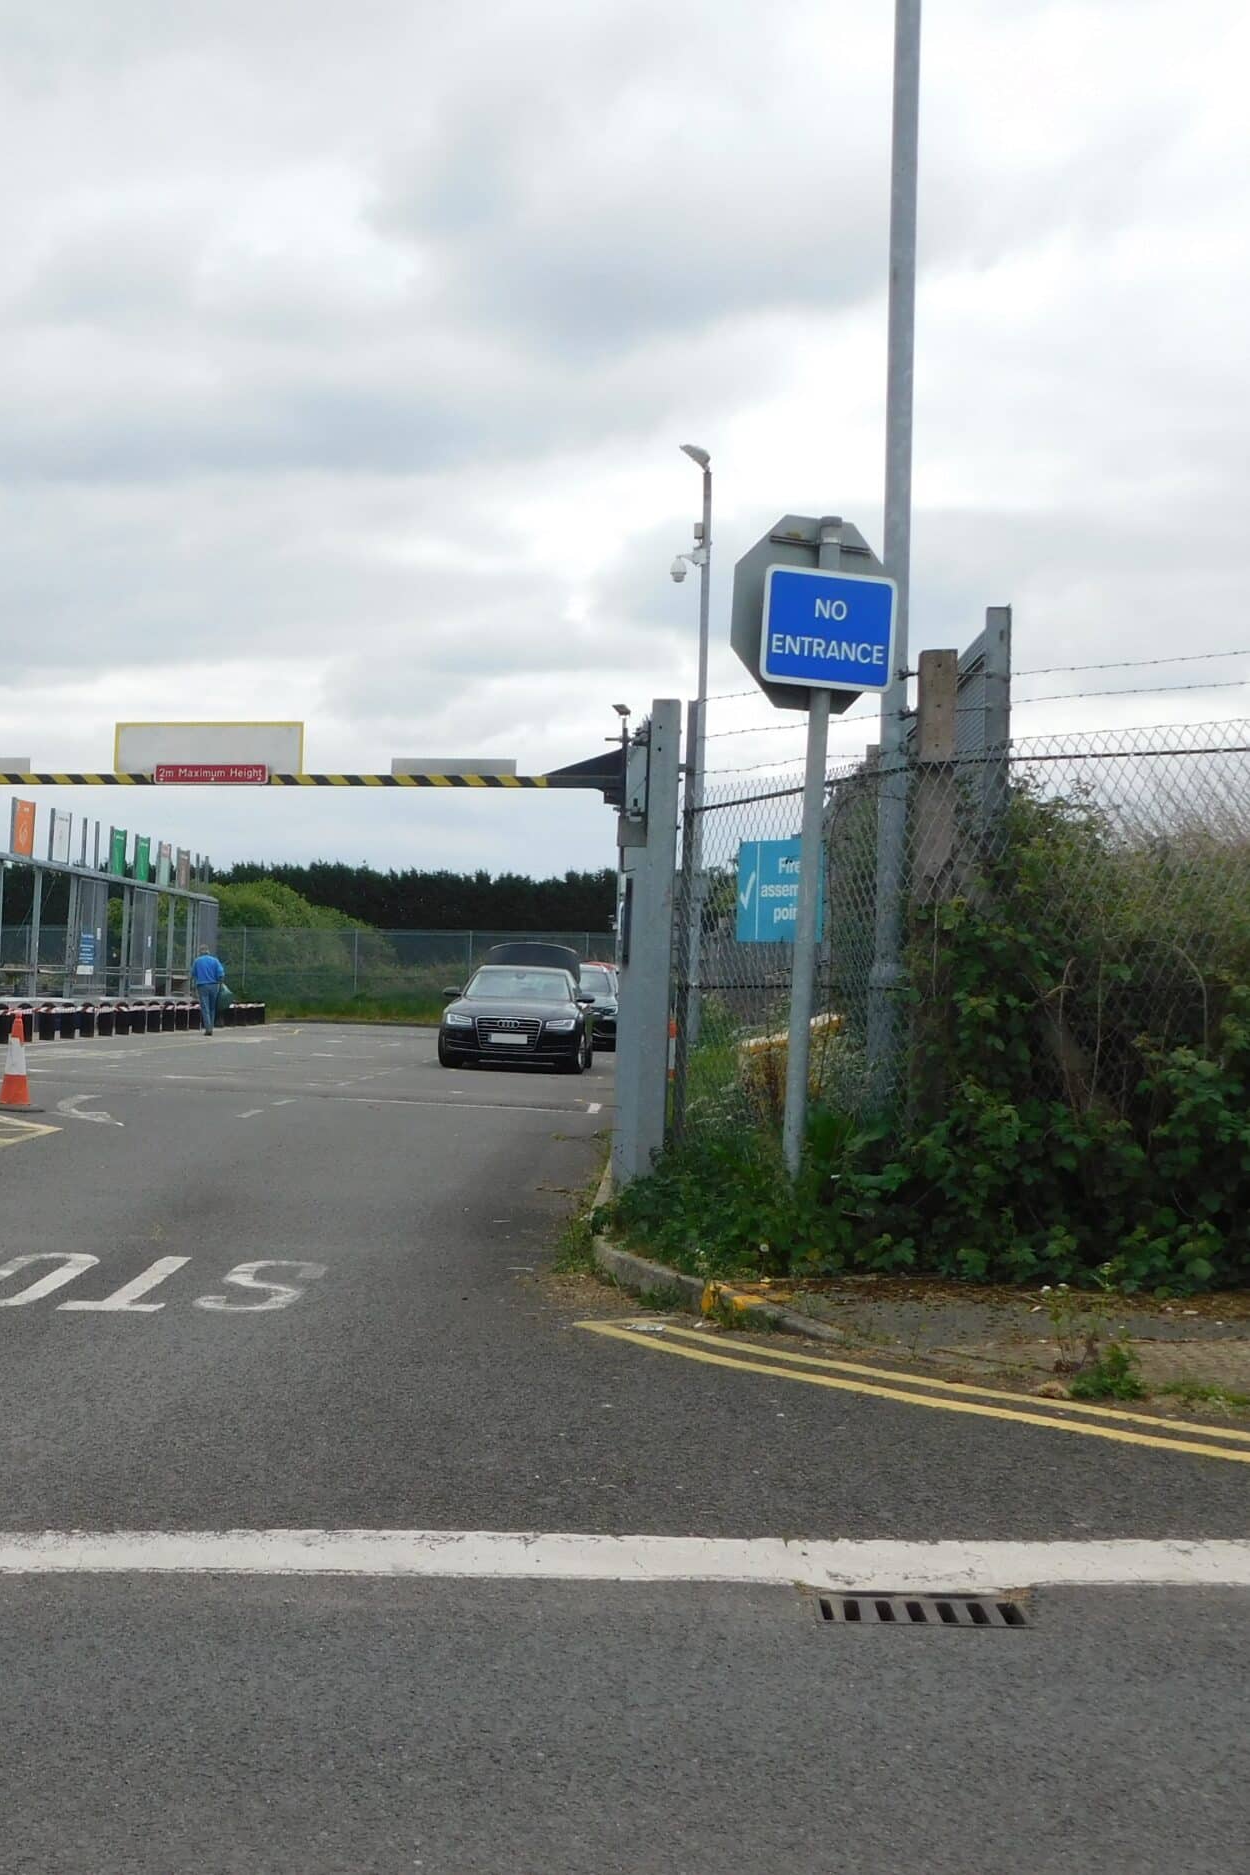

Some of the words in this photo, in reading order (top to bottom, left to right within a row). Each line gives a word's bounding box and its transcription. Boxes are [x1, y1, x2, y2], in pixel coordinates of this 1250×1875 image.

[814, 598, 847, 621] NO
[771, 633, 885, 665] ENTRANCE
[159, 768, 174, 777] 2m
[178, 768, 226, 777] Maximum
[230, 768, 262, 779] Height
[777, 856, 801, 875] Fire
[760, 884, 799, 898] assem
